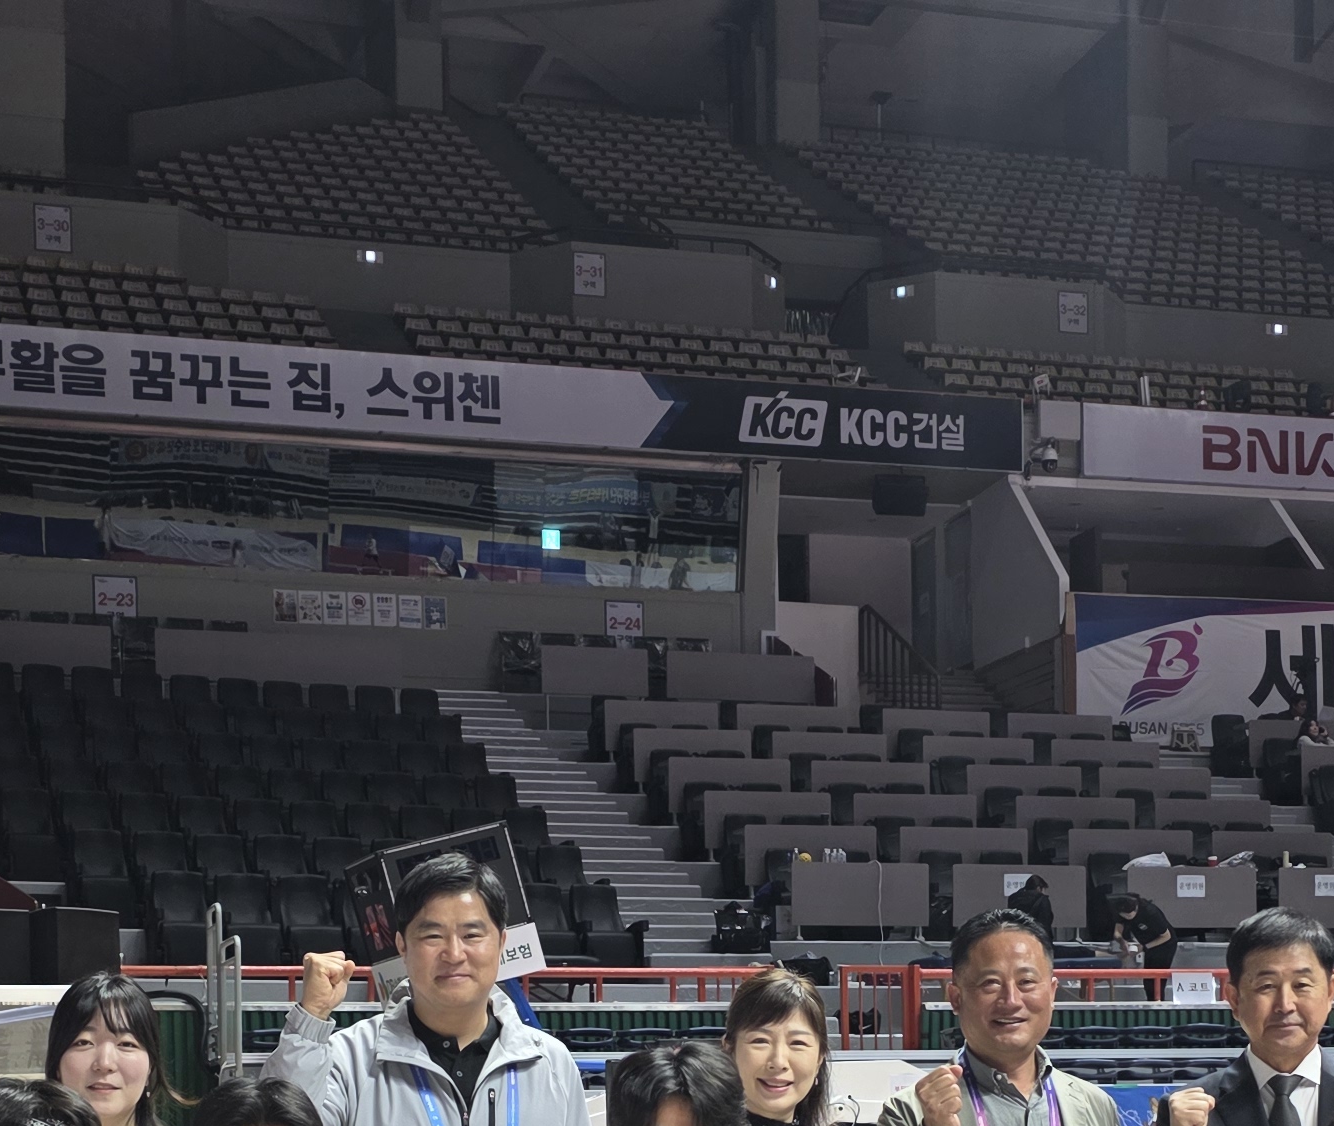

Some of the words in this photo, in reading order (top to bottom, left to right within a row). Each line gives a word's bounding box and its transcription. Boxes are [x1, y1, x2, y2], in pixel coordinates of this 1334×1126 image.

[37, 217, 70, 232] 3-30
[575, 265, 603, 278] 3-31
[1060, 303, 1086, 316] 3-32
[129, 348, 271, 409] 꿈꾸는
[287, 358, 345, 420] 집,
[366, 370, 502, 426] 스위첸
[746, 397, 822, 442] KCC
[839, 406, 965, 452] KCC건설
[98, 592, 134, 607] 2-23
[609, 617, 641, 631] 2-24
[1188, 983, 1210, 992] 코트
